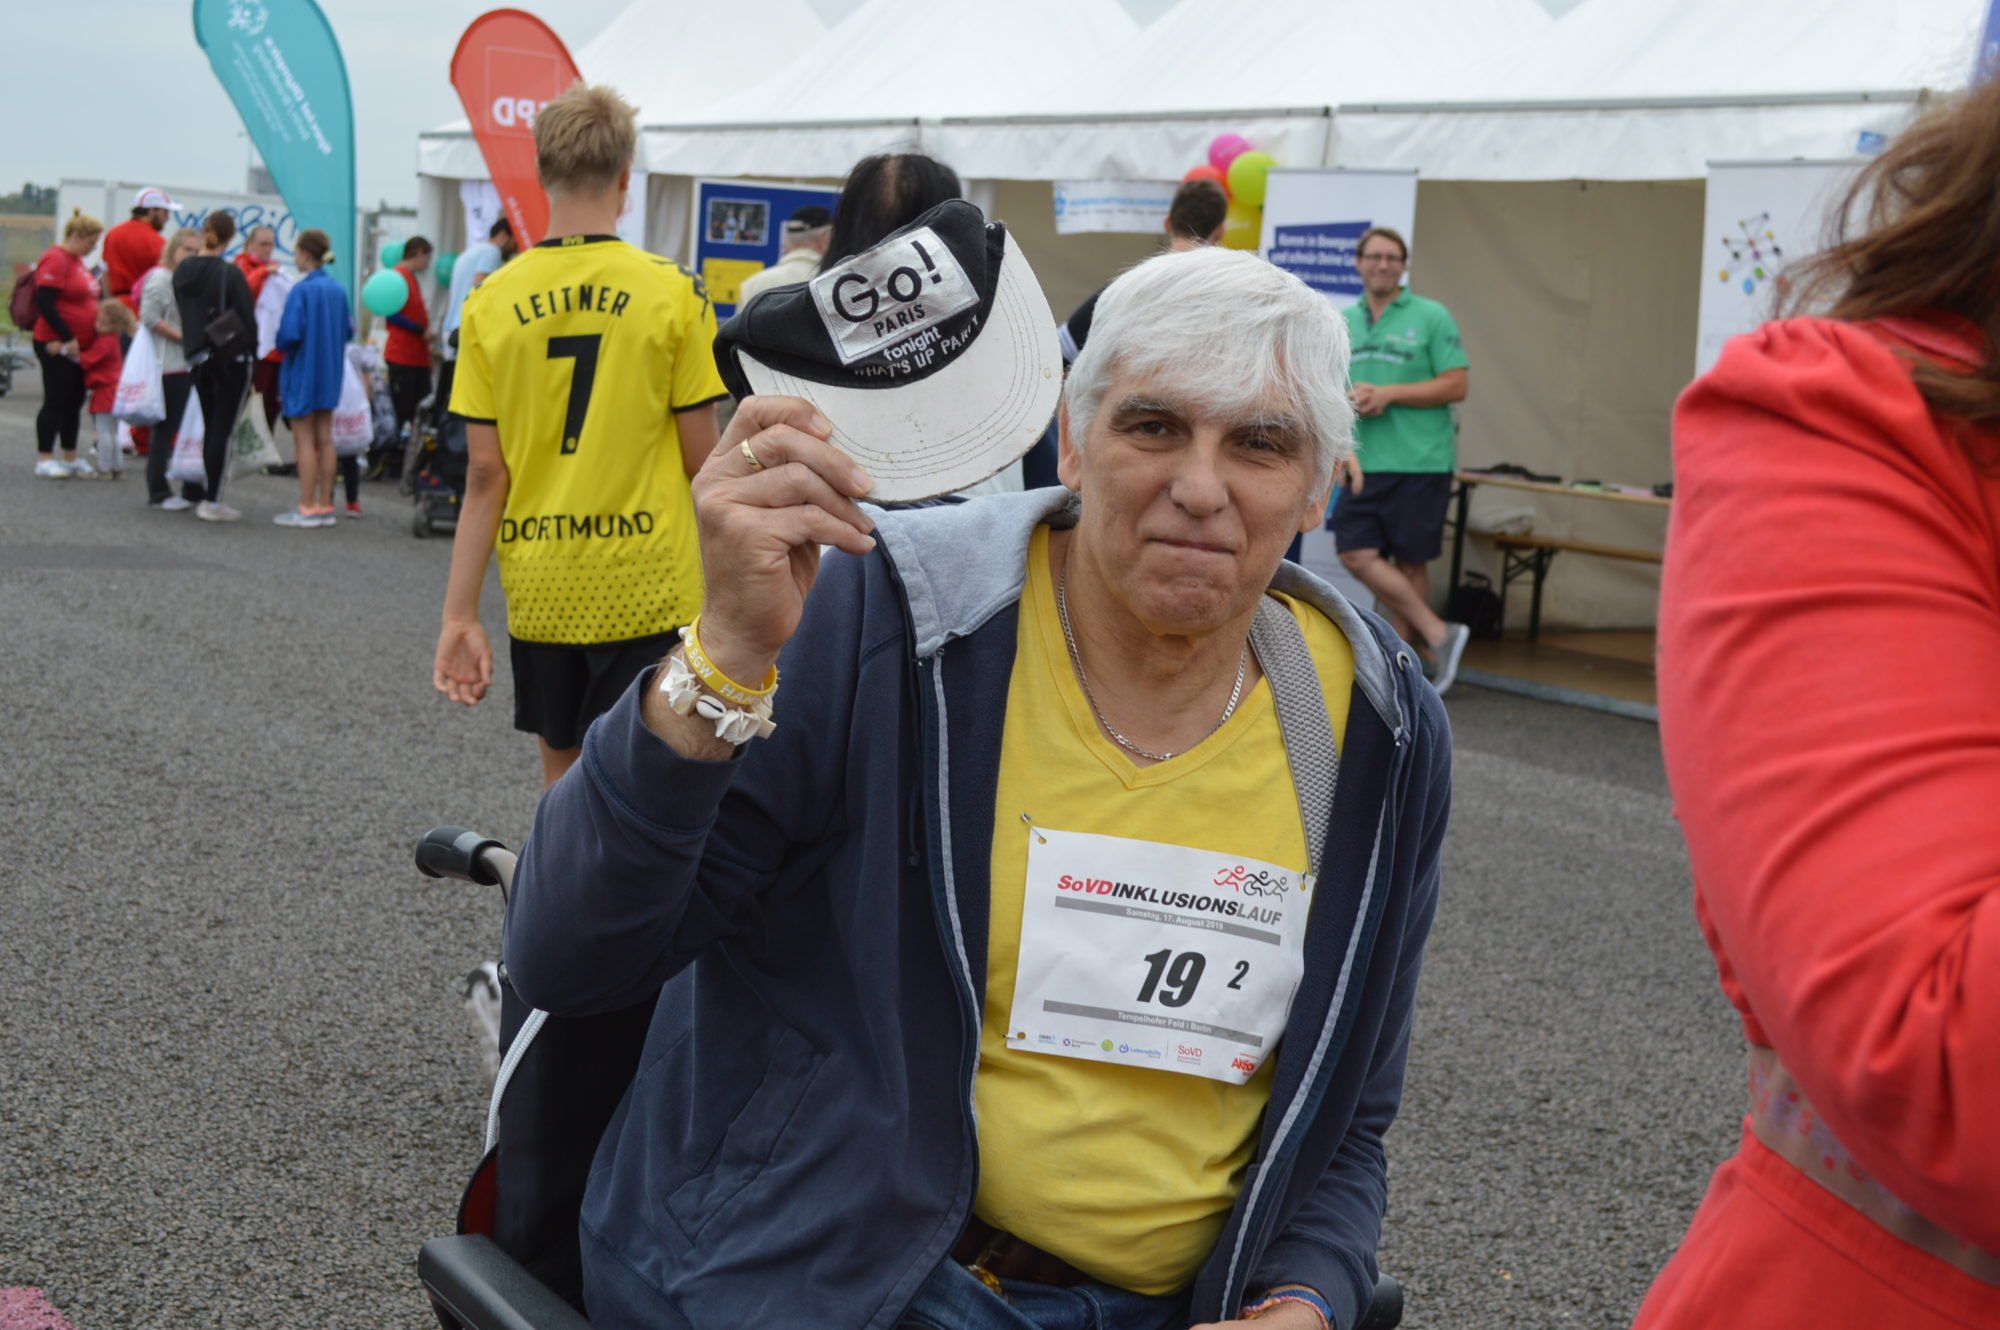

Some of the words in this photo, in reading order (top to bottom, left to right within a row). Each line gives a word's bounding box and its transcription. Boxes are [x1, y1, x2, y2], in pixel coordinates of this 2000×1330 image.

[832, 240, 942, 323] Go!
[513, 284, 631, 326] LEITNER
[873, 304, 926, 338] PARIS
[883, 326, 942, 361] tonight
[914, 348, 935, 369] UP
[547, 334, 602, 456] 7
[501, 511, 654, 543] DORTMUND
[1057, 875, 1283, 926] SoVDINKLUSIONSLAUF
[1126, 907, 1161, 922] Samstag,
[1163, 913, 1175, 924] 17.
[1176, 916, 1204, 928] August
[1136, 949, 1206, 1008] 19
[1227, 960, 1250, 990] 2
[1118, 1012, 1166, 1026] Tempelhofer
[1168, 1018, 1185, 1029] Feld
[1190, 1022, 1212, 1034] Berlin
[1177, 1044, 1203, 1058] SoVD
